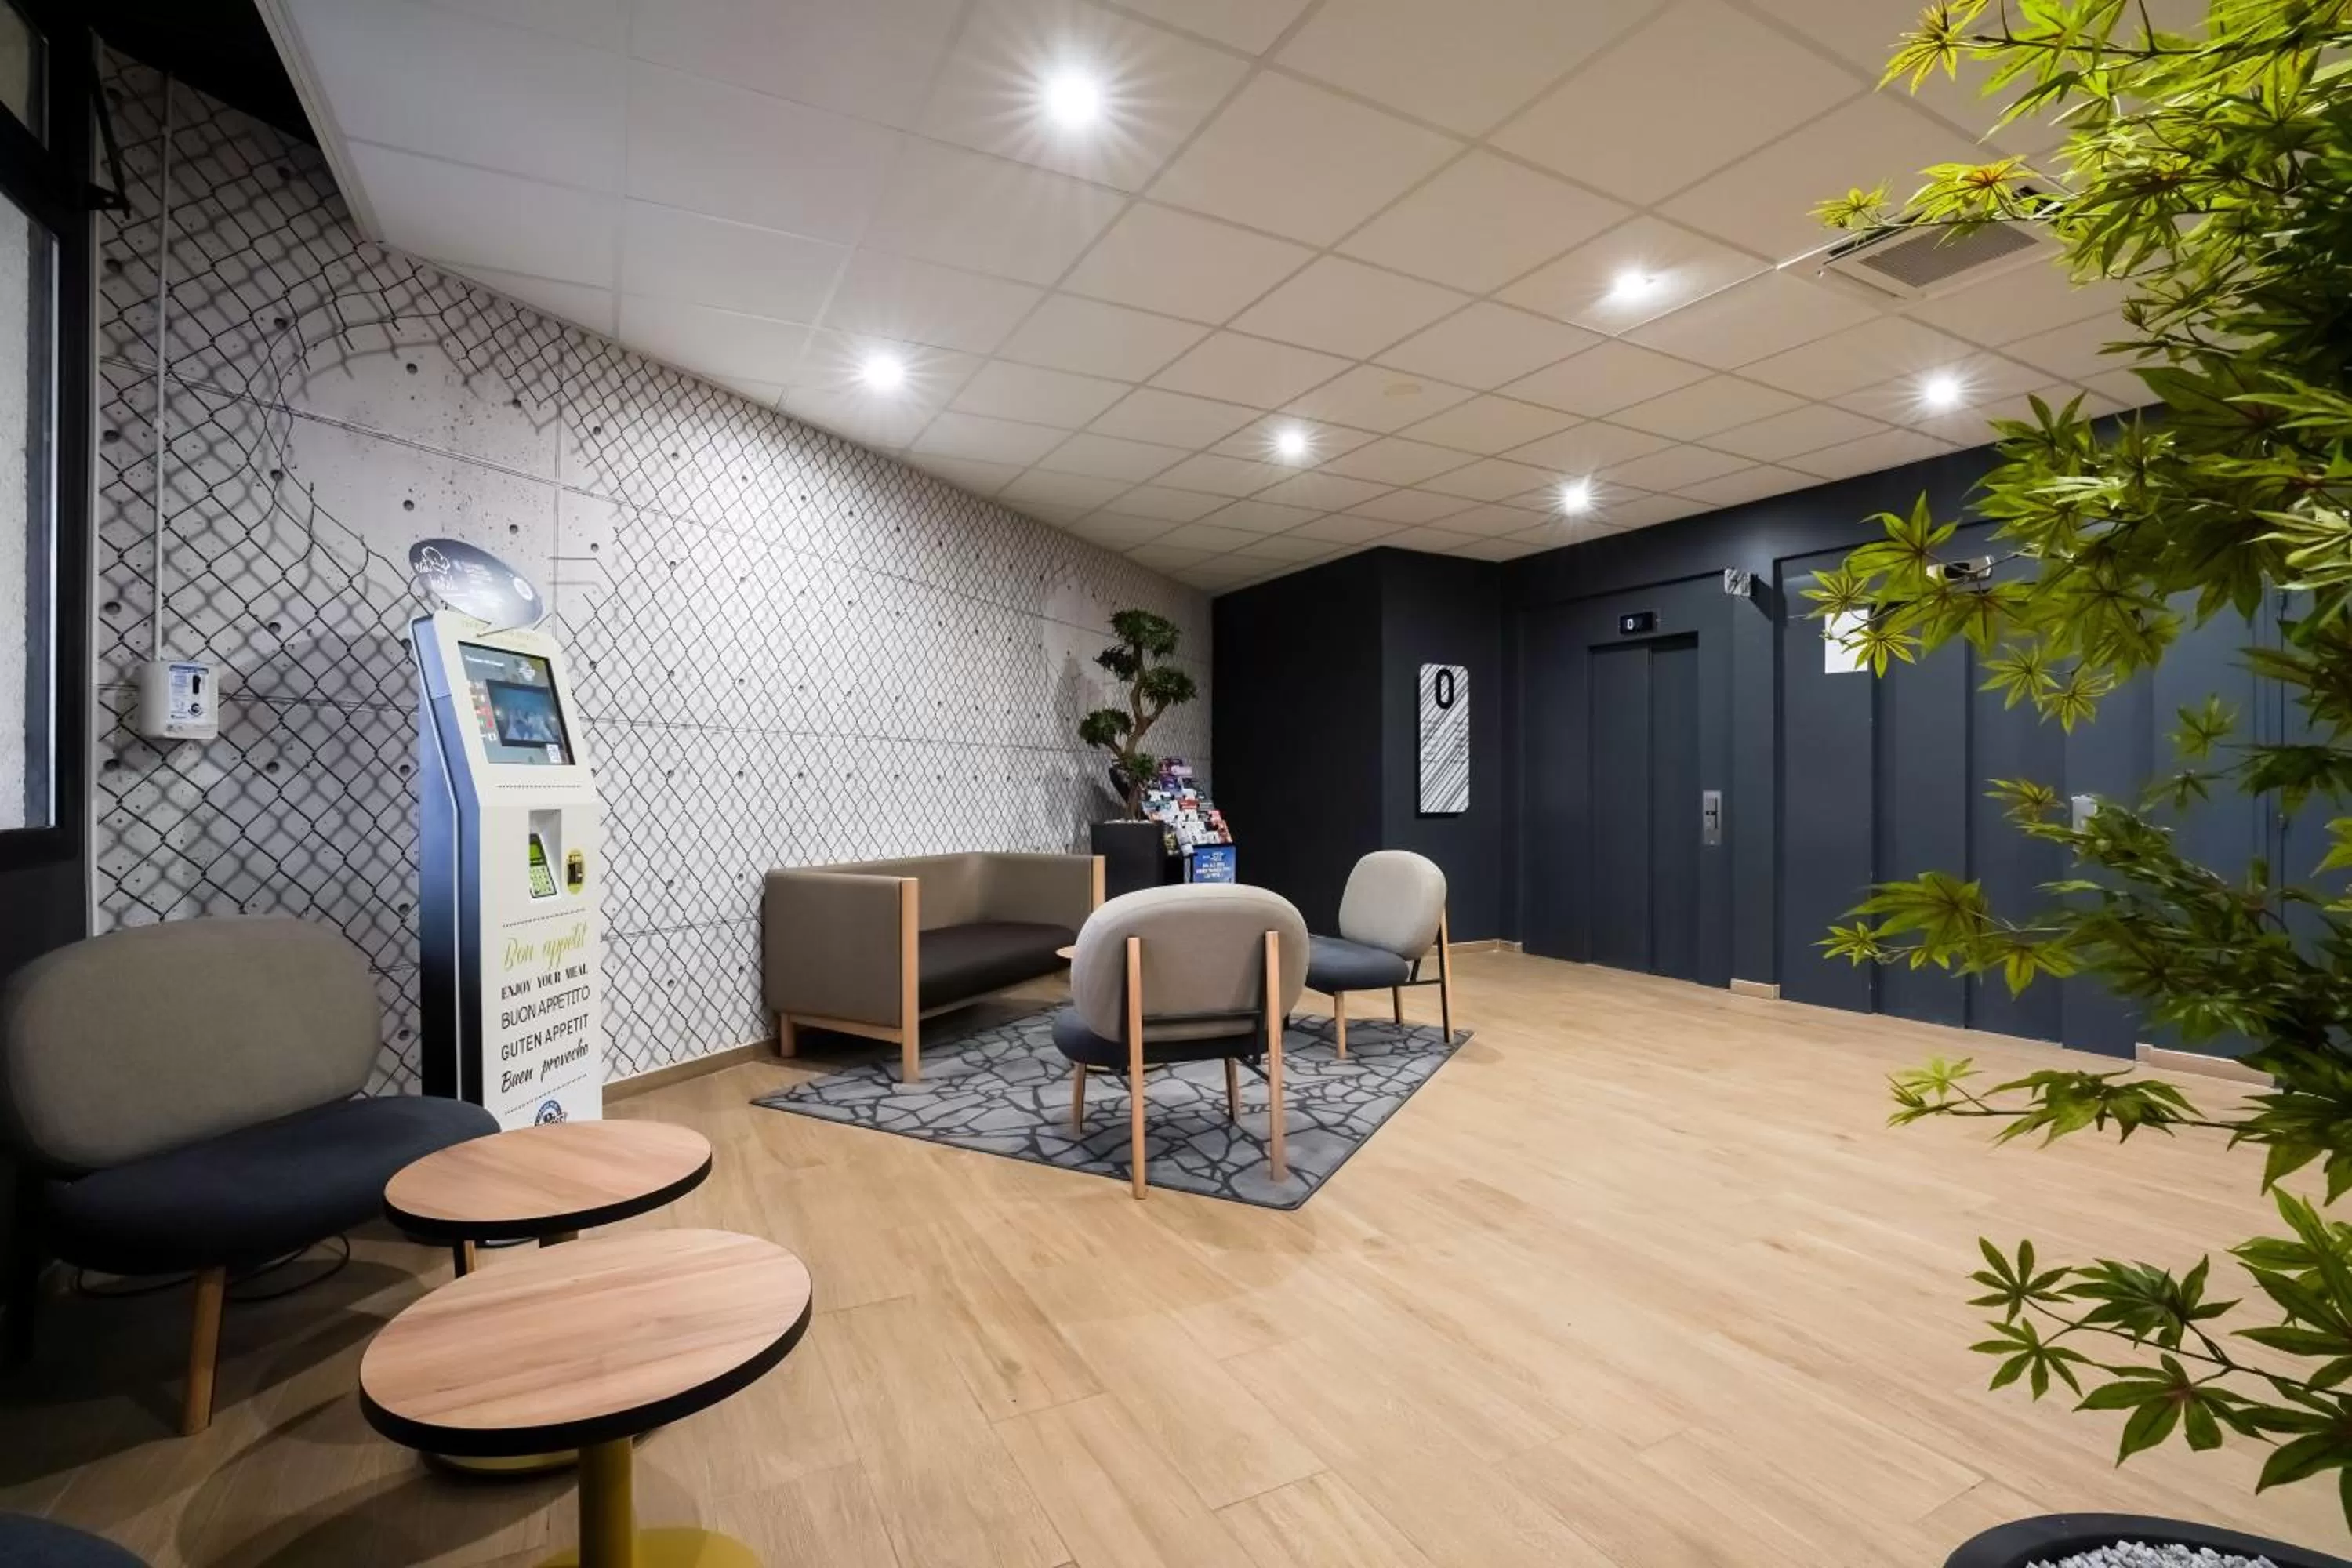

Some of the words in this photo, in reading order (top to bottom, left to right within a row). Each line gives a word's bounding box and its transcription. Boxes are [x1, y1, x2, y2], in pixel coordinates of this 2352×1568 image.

[1627, 619, 1634, 630] 0
[1435, 668, 1454, 710] 0
[503, 937, 534, 971] Bon
[502, 980, 531, 1000] ENJOY
[536, 971, 561, 989] YOUR
[502, 1004, 536, 1029] BUON
[538, 985, 590, 1017] APPETITO
[502, 1032, 542, 1061] GUTEN
[545, 1014, 589, 1044] APPETIT
[502, 1068, 533, 1094] Buen
